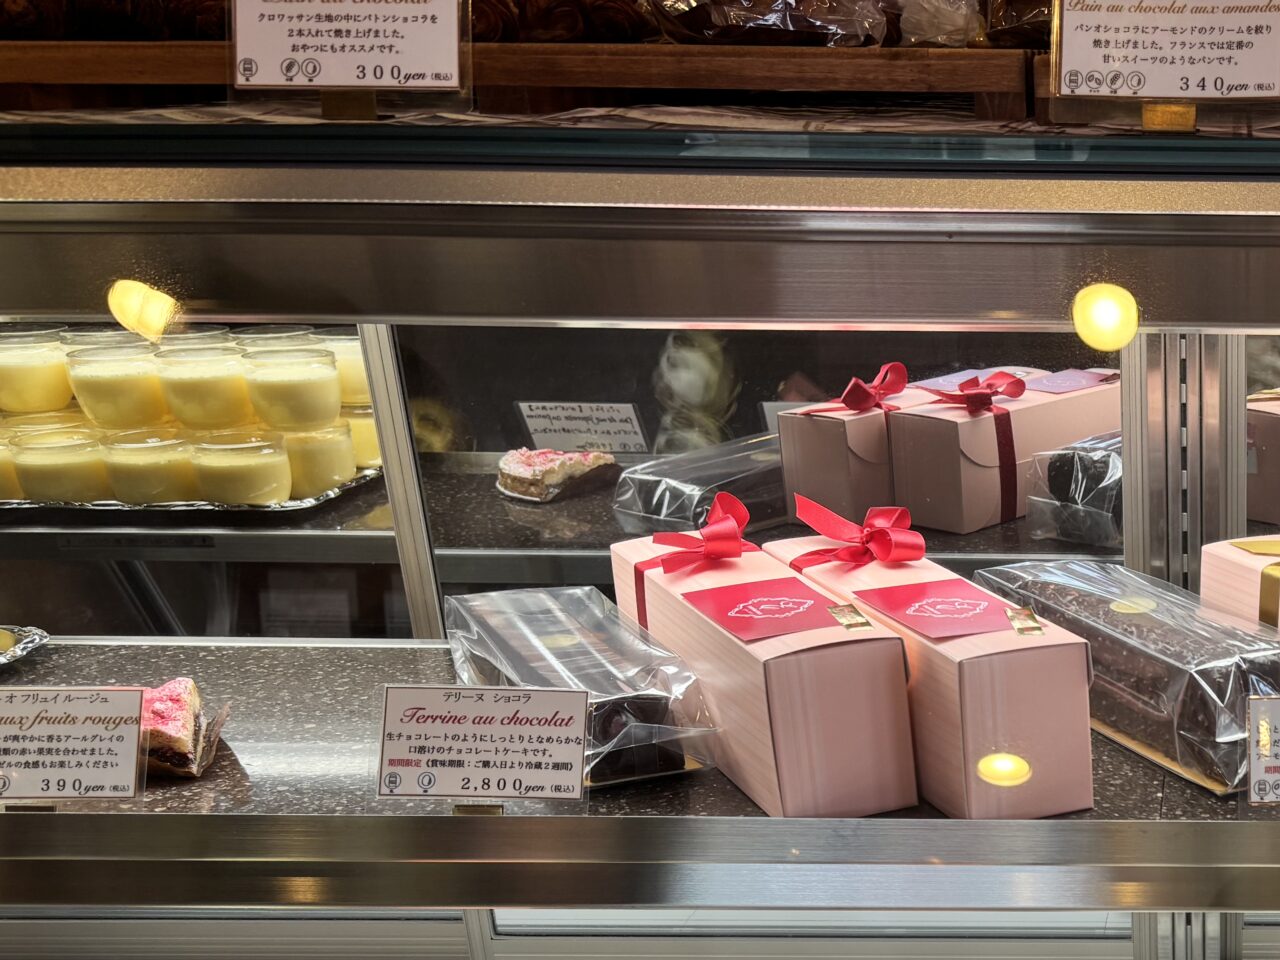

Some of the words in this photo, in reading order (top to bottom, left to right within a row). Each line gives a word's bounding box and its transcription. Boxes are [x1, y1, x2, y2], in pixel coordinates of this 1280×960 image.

[1066, 0, 1103, 13] Pain
[1107, 4, 1124, 14] au
[1127, 0, 1187, 14] chocolat
[1190, 5, 1219, 14] aux
[20, 692, 59, 705] フリュイ
[63, 693, 110, 704] ルージュ
[443, 691, 485, 703] テリーヌ
[493, 693, 533, 705] ショコラ
[19, 709, 77, 731] fruits
[81, 715, 140, 731] rouges
[399, 706, 470, 725] Terrine
[472, 715, 496, 726] au
[500, 709, 576, 728] chocolat
